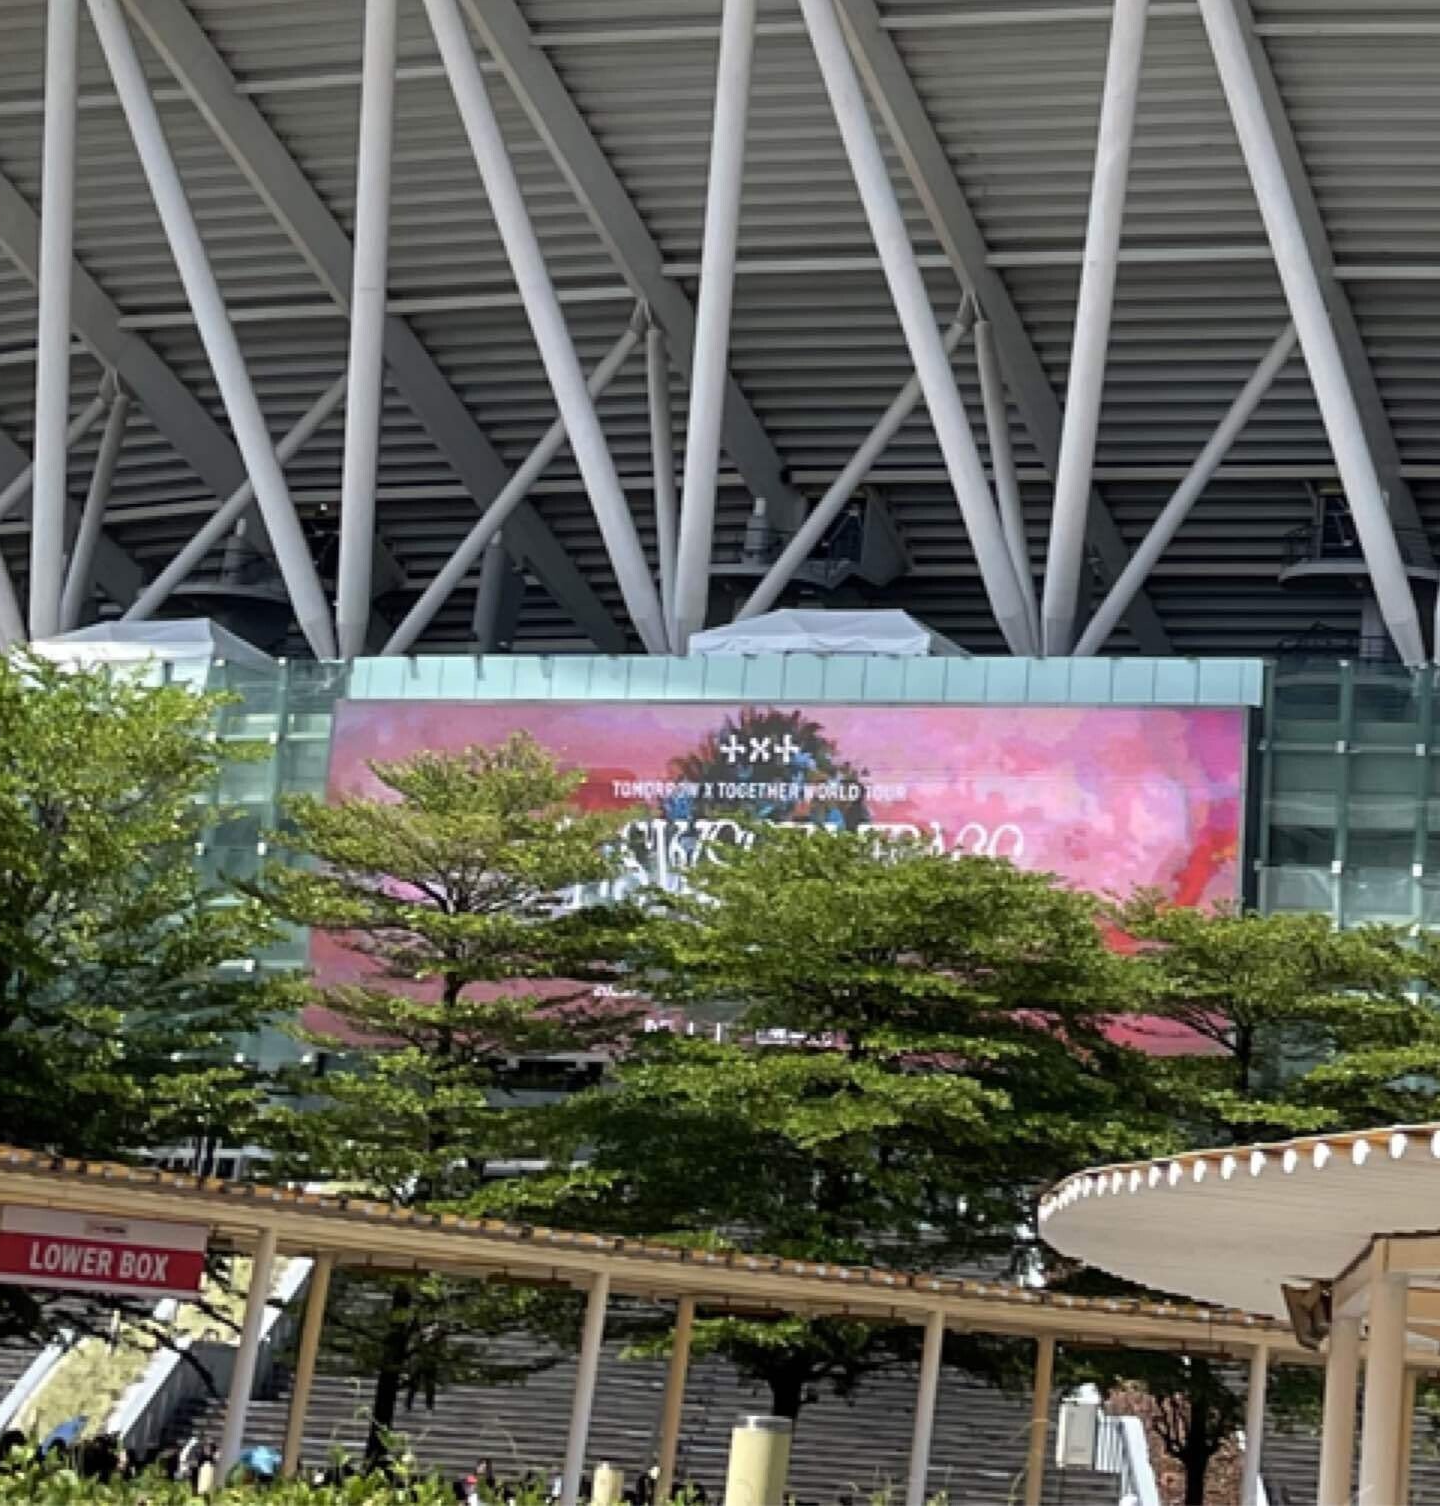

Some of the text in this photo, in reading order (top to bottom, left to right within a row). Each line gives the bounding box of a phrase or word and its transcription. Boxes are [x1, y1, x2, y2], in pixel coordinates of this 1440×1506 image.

[717, 781, 800, 800] TOGETHER
[803, 782, 860, 801] WORLD
[29, 1241, 169, 1282] LOWER BOX
